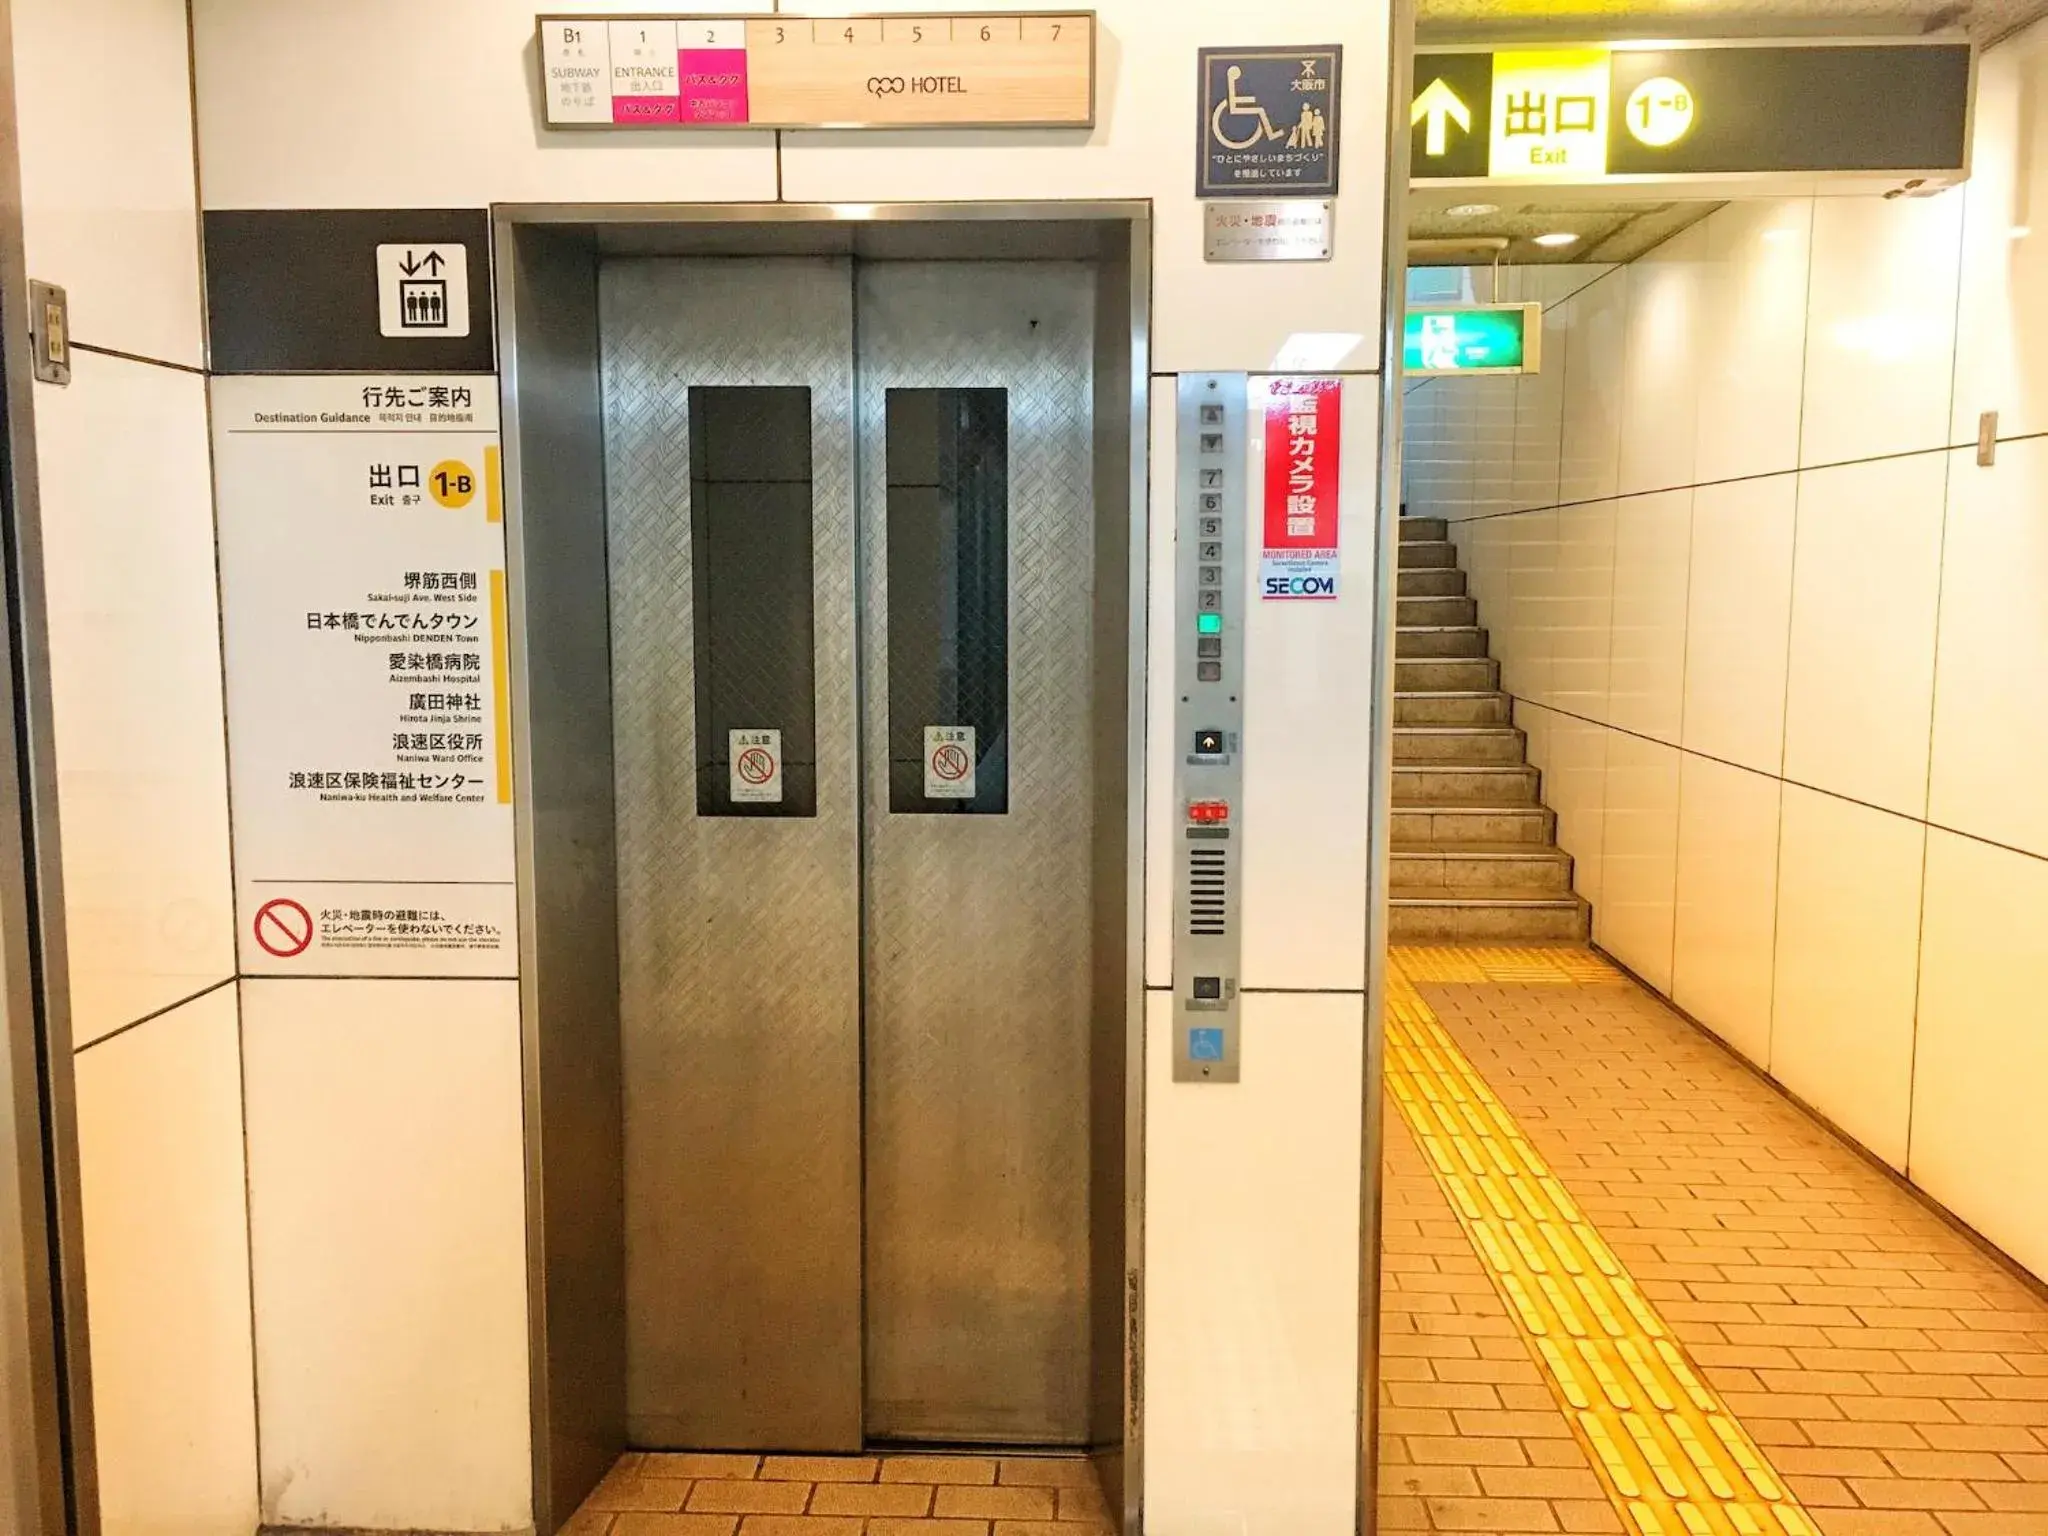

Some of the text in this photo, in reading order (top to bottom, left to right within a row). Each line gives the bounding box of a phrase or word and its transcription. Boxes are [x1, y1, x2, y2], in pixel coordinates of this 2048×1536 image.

[563, 27, 581, 44] B1
[639, 30, 646, 43] 1
[706, 30, 715, 43] 2
[776, 26, 785, 44] 3
[843, 26, 854, 43] 4
[912, 26, 922, 43] 5
[980, 25, 991, 42] 6
[1051, 24, 1061, 41] 7
[551, 67, 601, 79] SUBWAY
[614, 66, 674, 78] ENTRANCE
[630, 78, 664, 92] 出入口
[911, 76, 967, 94] HOTEL
[1291, 79, 1325, 91] 大阪市
[1505, 90, 1596, 137] 出口
[1636, 95, 1688, 129] 1-B
[1530, 147, 1567, 165] Exit
[363, 386, 472, 408] 行先ご案内
[254, 412, 371, 423] Destination Guidance
[370, 464, 420, 488] 出口
[1206, 471, 1216, 485] 7
[435, 471, 472, 497] 1-B
[370, 494, 394, 506] Exit
[1206, 496, 1216, 509] 6
[1206, 521, 1216, 534] 5
[1205, 545, 1215, 557] 4
[1262, 549, 1338, 559] MONITORED AREA
[404, 572, 477, 590] 堺筋西側
[1206, 569, 1215, 582] 3
[1266, 576, 1334, 594] SECOM
[368, 593, 478, 603] Sakai-suji Ave. West Side
[1206, 593, 1215, 606] 2
[306, 612, 478, 630] 日本橋でんでんタウン
[354, 634, 479, 644] Nipponbashi DENDEN Town
[389, 653, 481, 671] 愛染橋病院
[443, 674, 480, 684] Hospital
[409, 693, 482, 711] 廣田神社
[399, 714, 482, 724] Hirota Jinja Shrine
[392, 733, 483, 751] 浪速区役所
[397, 754, 484, 763] Naniwa Ward Office
[288, 771, 484, 790] 浪速区保険福祉センター
[320, 793, 485, 803] Naniwa-ku Health and Welfare Center
[320, 908, 446, 921] 火災・地震時の避難には、
[320, 923, 501, 935] エレベーターを使わないでください。
